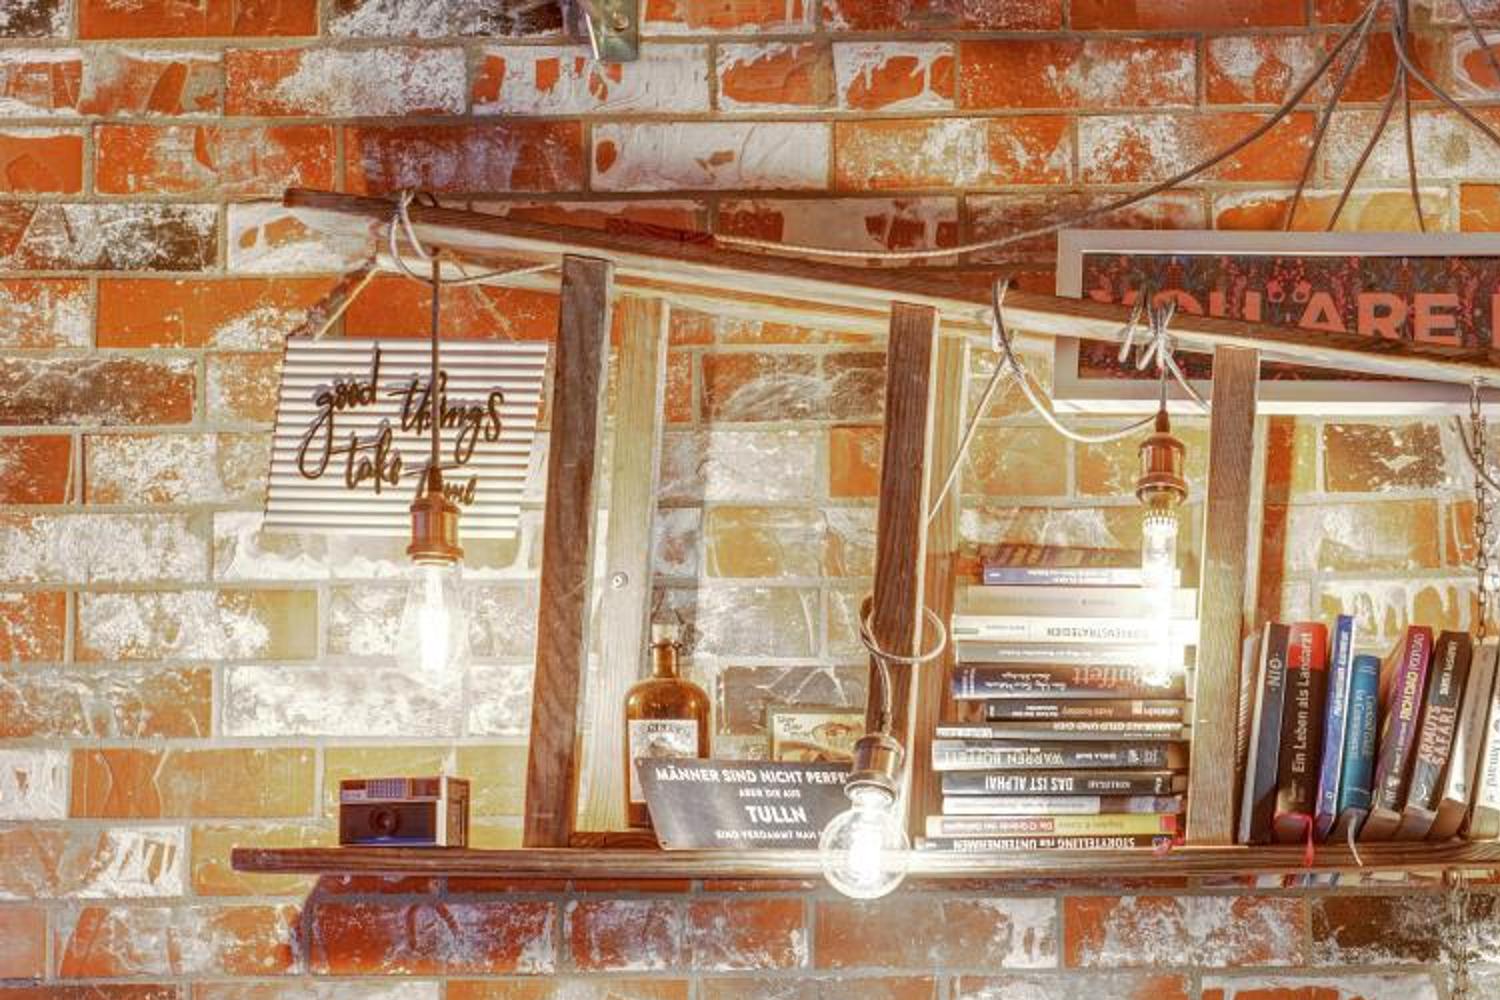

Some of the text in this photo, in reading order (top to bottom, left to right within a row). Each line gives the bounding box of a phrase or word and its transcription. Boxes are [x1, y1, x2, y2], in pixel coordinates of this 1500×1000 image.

[1267, 657, 1283, 688] GIN
[655, 765, 720, 783] MÄNNER
[721, 769, 758, 783] SIND
[760, 770, 803, 784] NICHT
[1051, 775, 1075, 791] DAS
[1030, 776, 1048, 791] IST
[745, 805, 807, 823] TULLN
[1057, 836, 1136, 849] STORYTELLING
